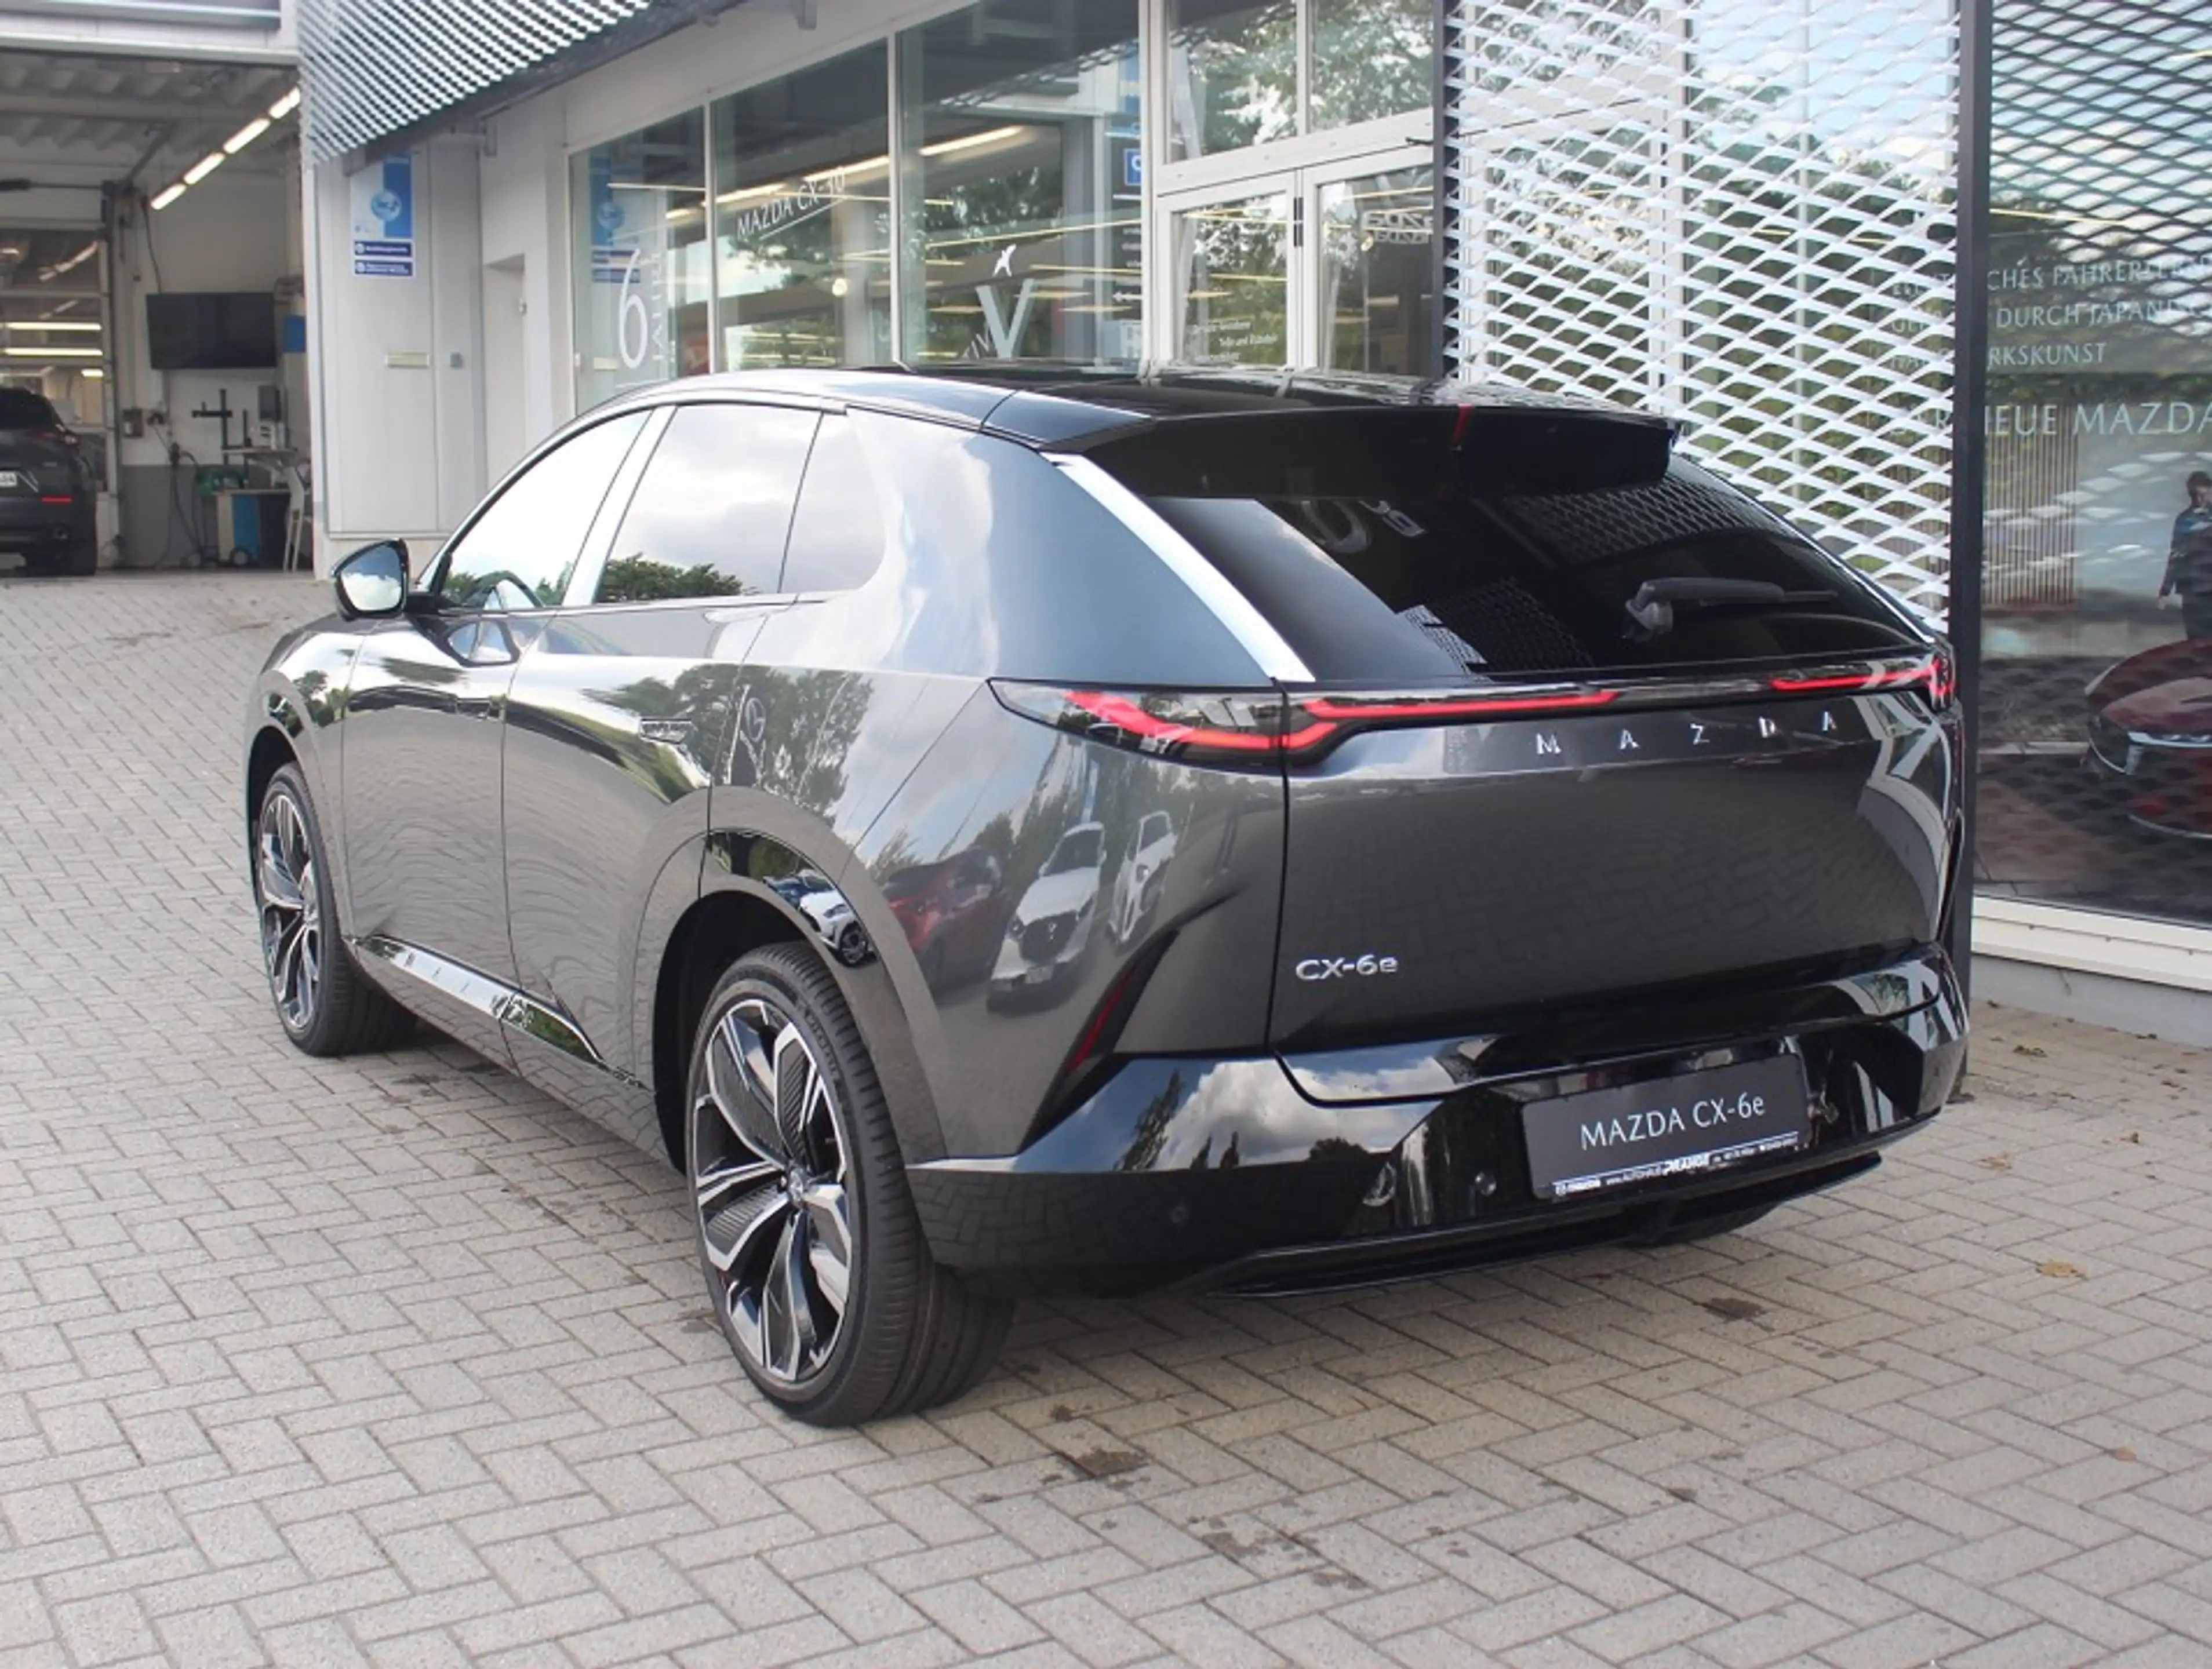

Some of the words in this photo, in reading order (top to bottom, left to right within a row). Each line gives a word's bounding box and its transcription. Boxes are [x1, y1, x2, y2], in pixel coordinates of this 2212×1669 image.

[737, 198, 793, 242] MAZDA
[619, 248, 648, 370] 6
[1996, 305, 2079, 328] DURCH
[1984, 405, 2057, 435] EUE
[1536, 711, 1837, 755] MAZDA
[1296, 953, 1398, 981] CX-6e
[1581, 1107, 1686, 1151] MAZDA
[1692, 1092, 1766, 1128] CX-6e
